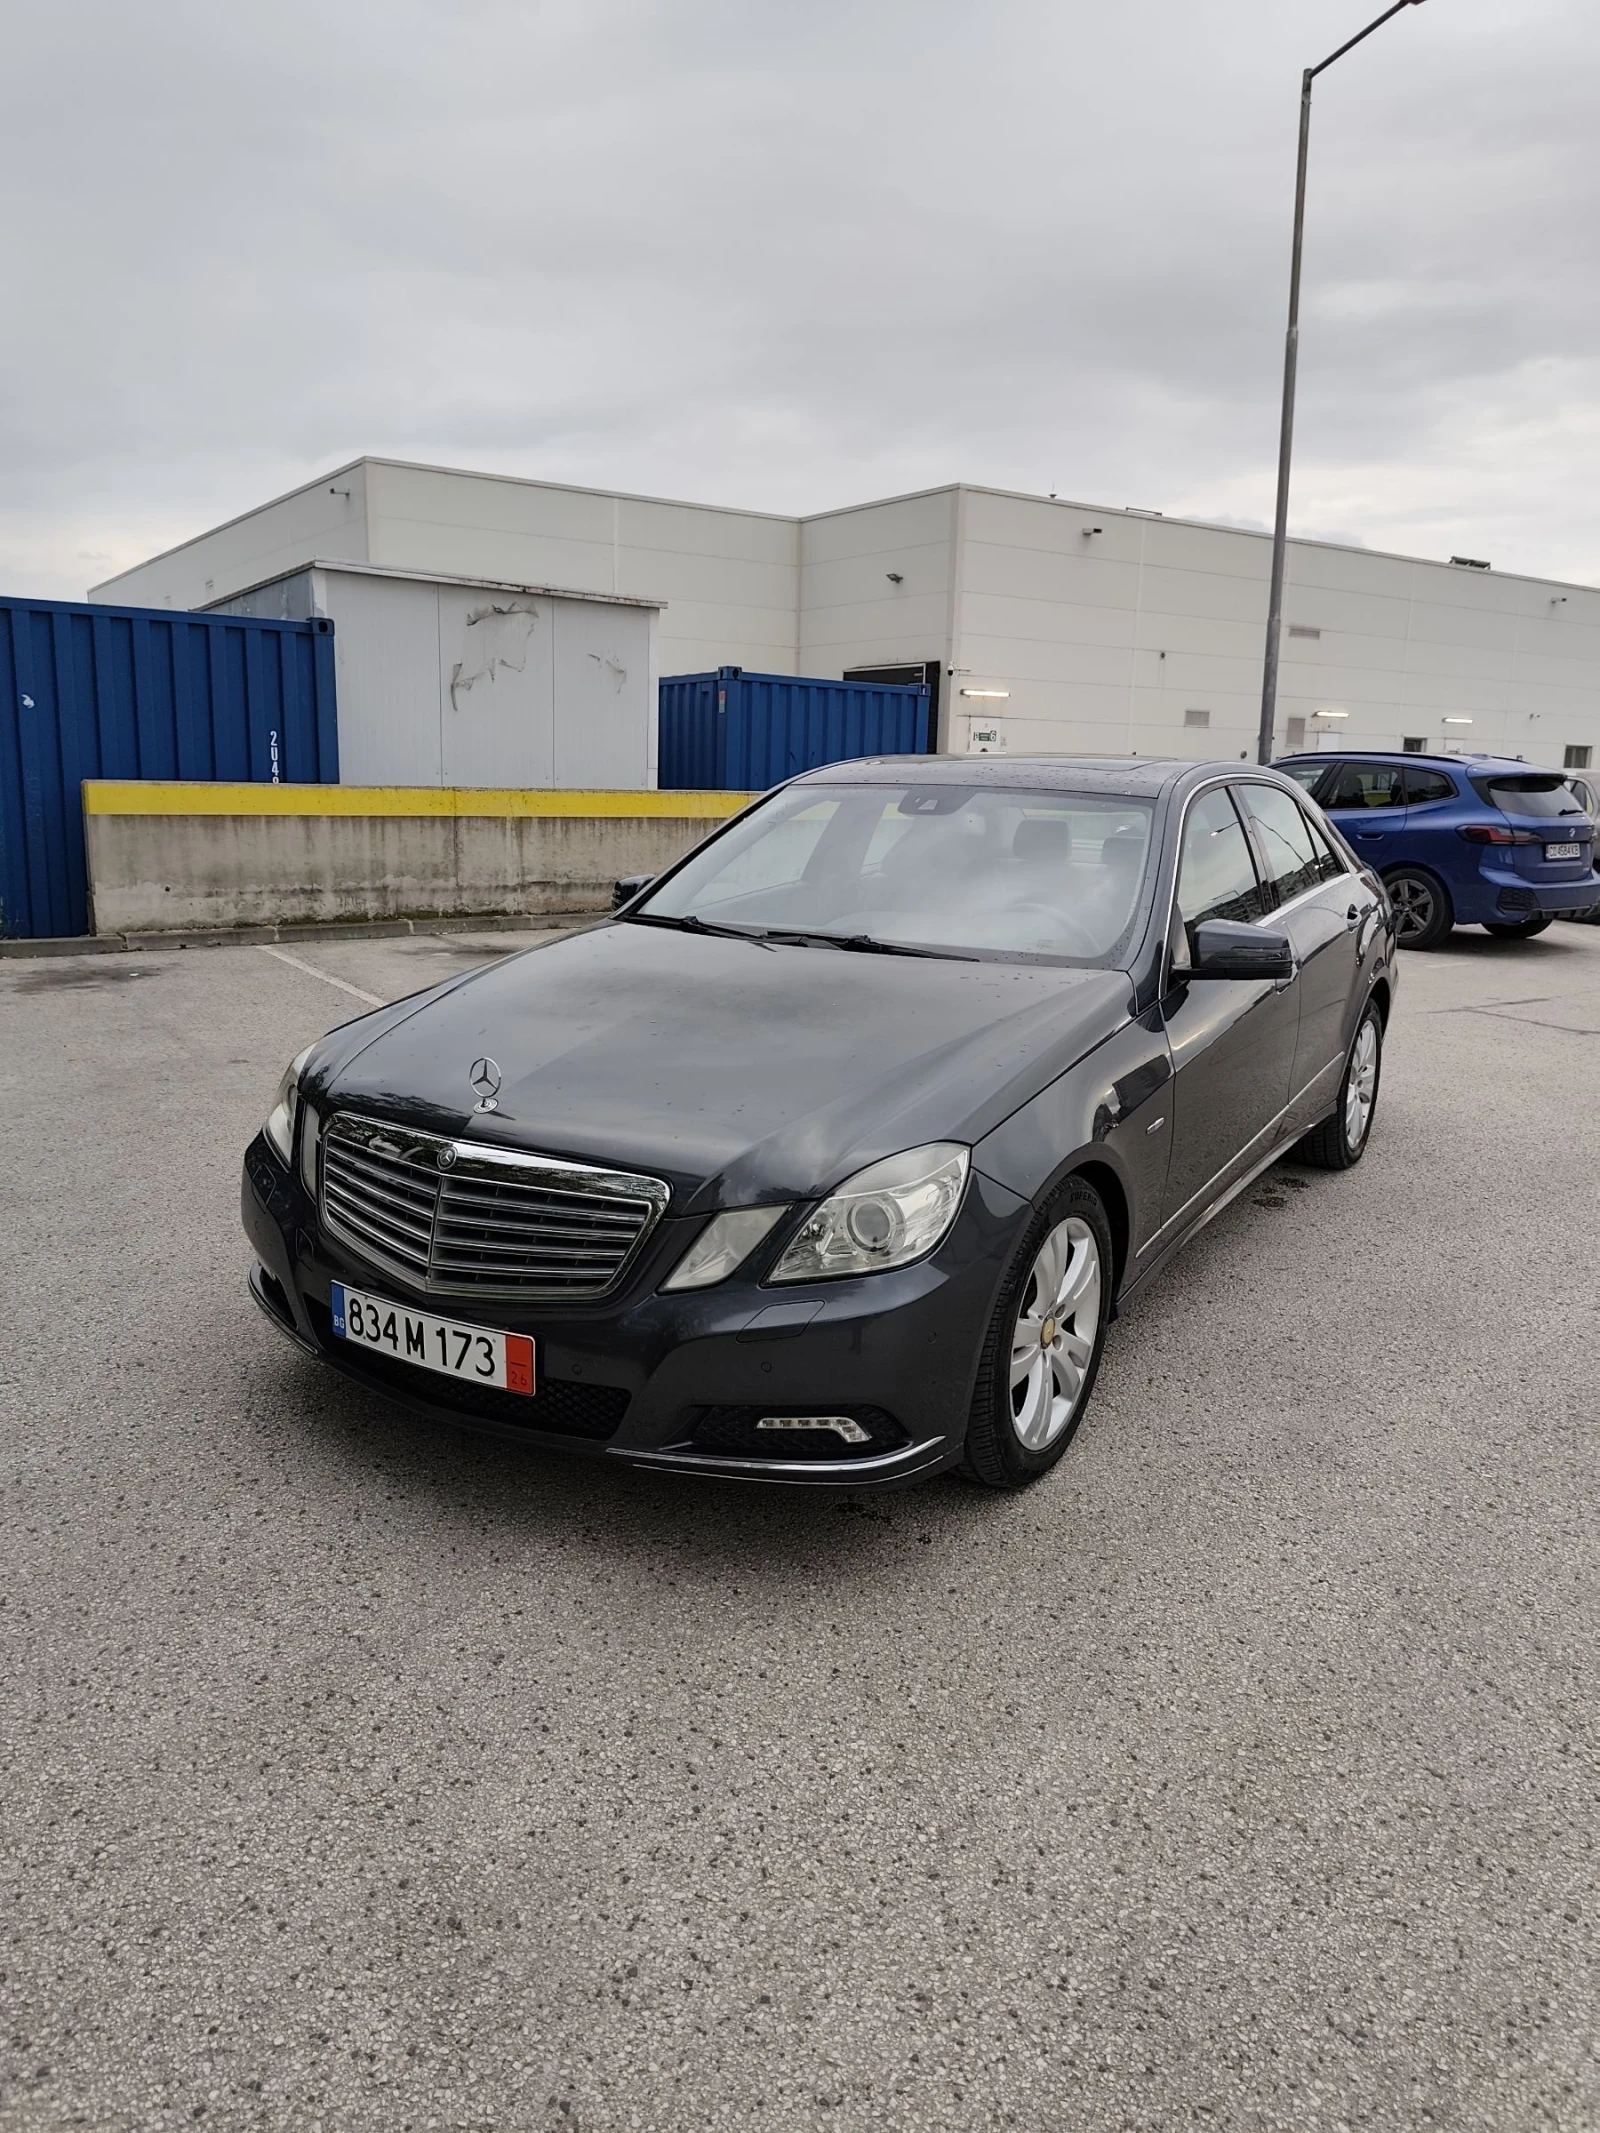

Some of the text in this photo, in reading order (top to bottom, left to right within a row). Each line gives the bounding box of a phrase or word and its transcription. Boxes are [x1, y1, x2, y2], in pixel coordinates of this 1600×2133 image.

[333, 1315, 345, 1329] BG
[349, 1298, 496, 1377] 834 M 173
[511, 1371, 528, 1387] 26
